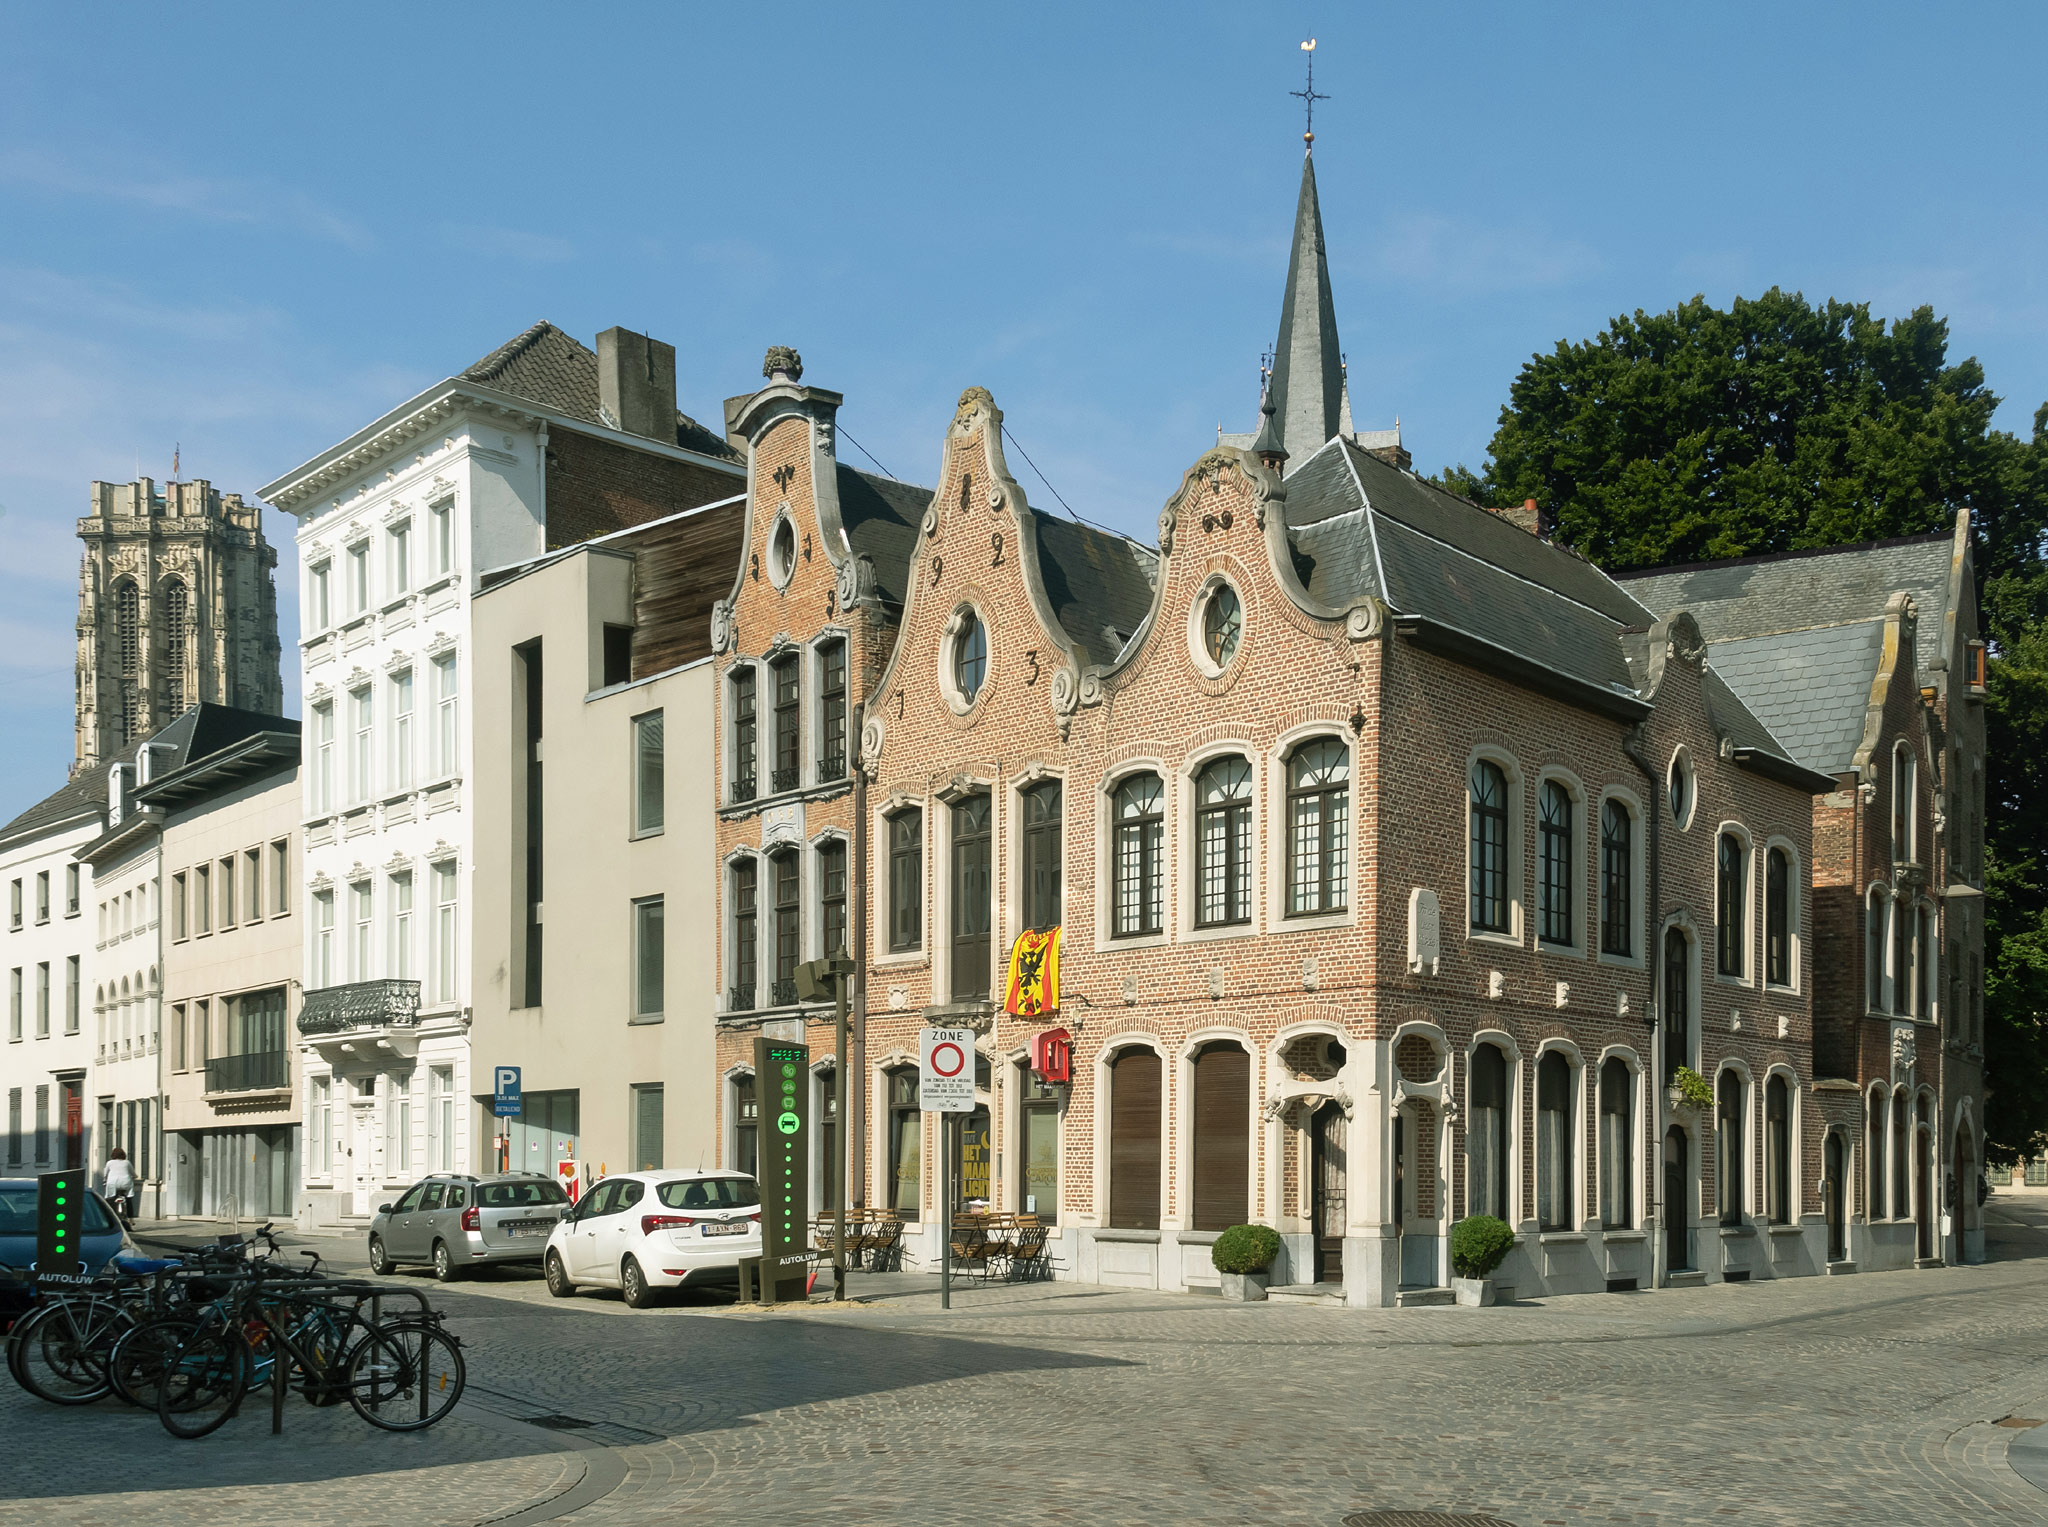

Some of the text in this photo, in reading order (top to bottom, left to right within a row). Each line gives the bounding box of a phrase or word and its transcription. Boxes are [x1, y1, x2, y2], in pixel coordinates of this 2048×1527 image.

[932, 556, 943, 587] 9
[1026, 650, 1040, 686] 3
[932, 1031, 963, 1041] ZONE
[499, 1070, 517, 1095] P
[963, 1145, 981, 1160] HET
[780, 1252, 818, 1266] AUTOLUW
[38, 1273, 94, 1284] AUTOLUW
